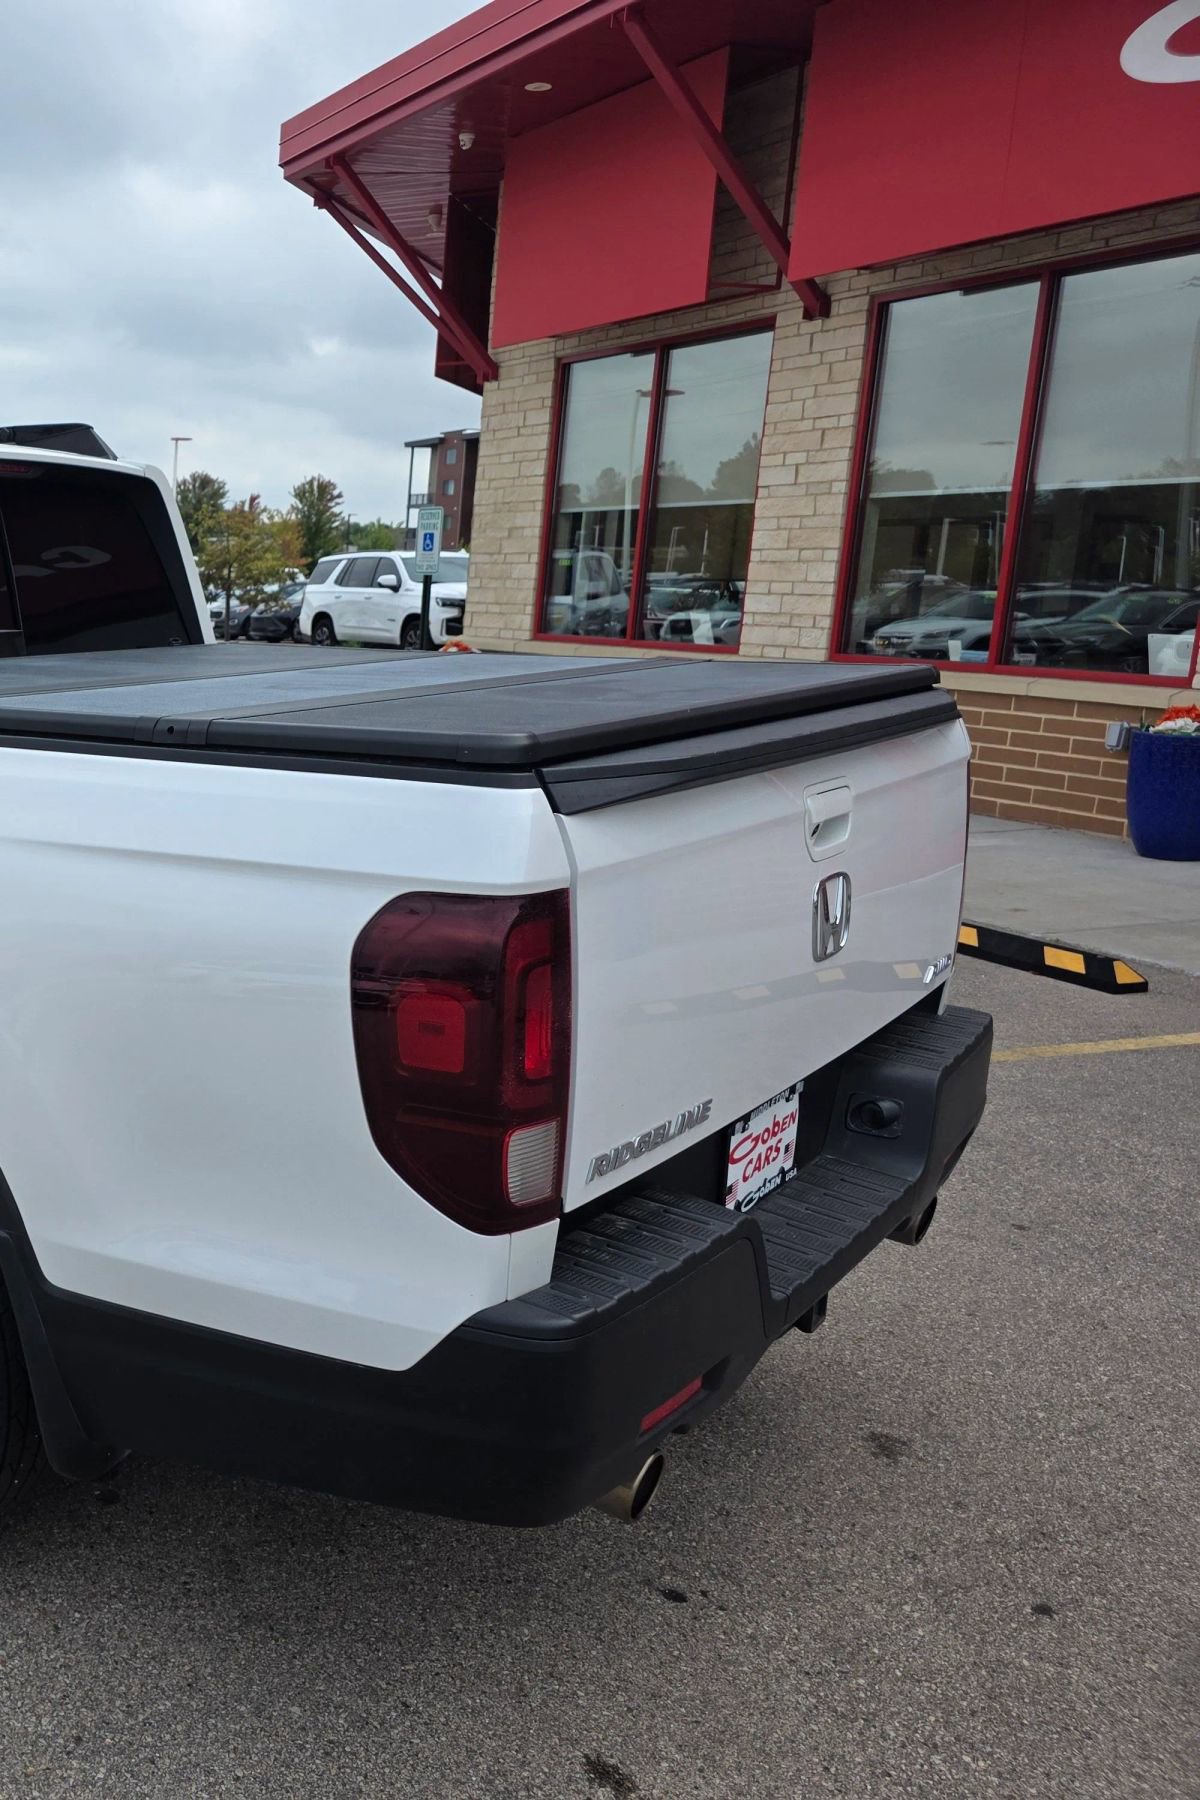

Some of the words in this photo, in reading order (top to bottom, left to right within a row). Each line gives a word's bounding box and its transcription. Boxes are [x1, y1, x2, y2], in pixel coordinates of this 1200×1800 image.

[750, 1089, 791, 1120] MIDDLETON
[585, 1098, 713, 1185] RIDGELINE
[742, 1138, 782, 1183] CARS
[785, 1168, 797, 1182] USA
